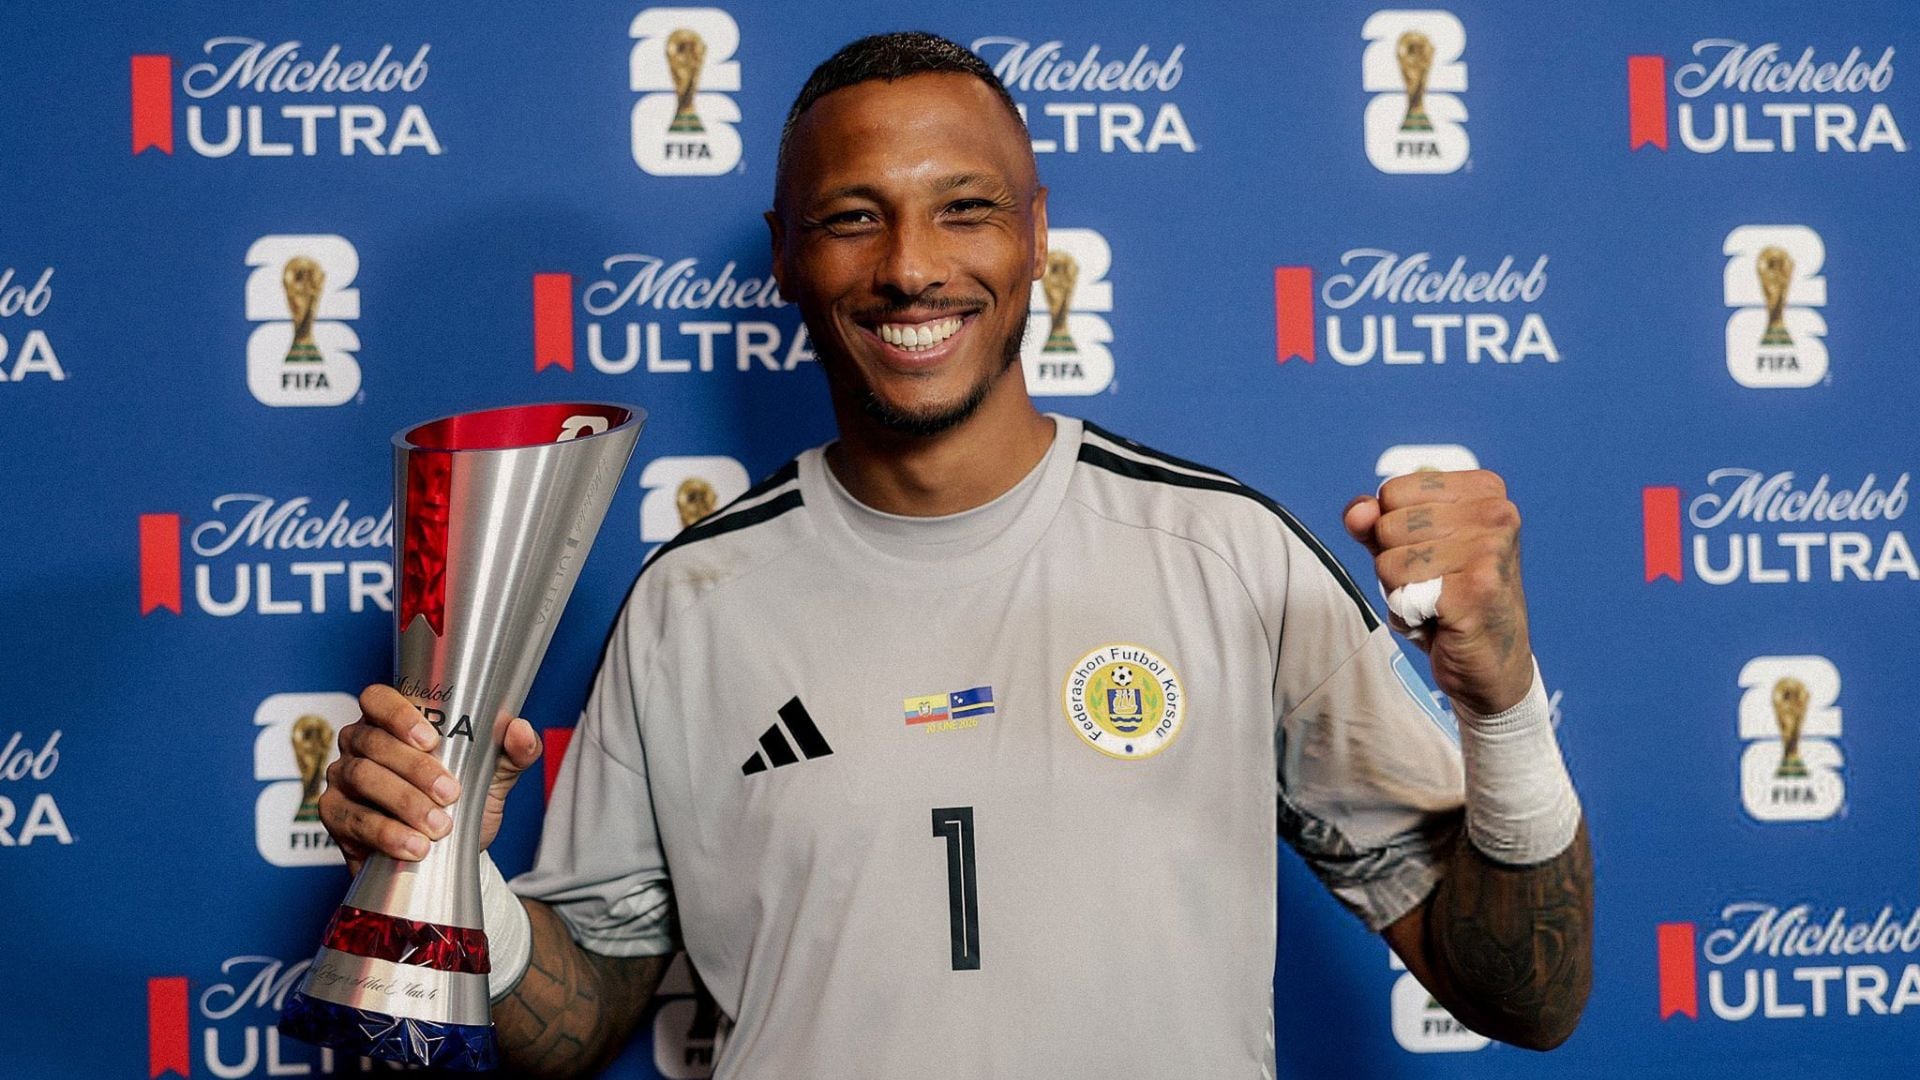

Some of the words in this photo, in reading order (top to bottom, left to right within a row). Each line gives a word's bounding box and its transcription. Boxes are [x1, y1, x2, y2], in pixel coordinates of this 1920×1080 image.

[183, 37, 431, 98] Michelob
[975, 36, 1185, 92] Michelob
[1674, 38, 1895, 97] Michelob
[187, 105, 442, 157] ULTRA
[664, 142, 712, 160] FIFA
[1013, 103, 1196, 152] TRA
[1395, 140, 1441, 158] FIFA
[1678, 103, 1907, 153] ULTRA
[583, 253, 788, 316] Michel
[1322, 248, 1549, 309] Michelob
[1326, 313, 1560, 365] ULTRA
[1756, 354, 1801, 372] FIFA
[281, 372, 330, 390] FIFA
[1039, 363, 1084, 379] FIFA
[191, 493, 393, 556] Michel
[1689, 468, 1910, 528] Michelob
[1693, 531, 1920, 585] ULTRA
[195, 561, 393, 617] ULTR
[1073, 655, 1106, 741] Federashon
[1771, 786, 1817, 804] FIFA
[931, 805, 981, 971] 1
[1703, 902, 1920, 964] Michelob
